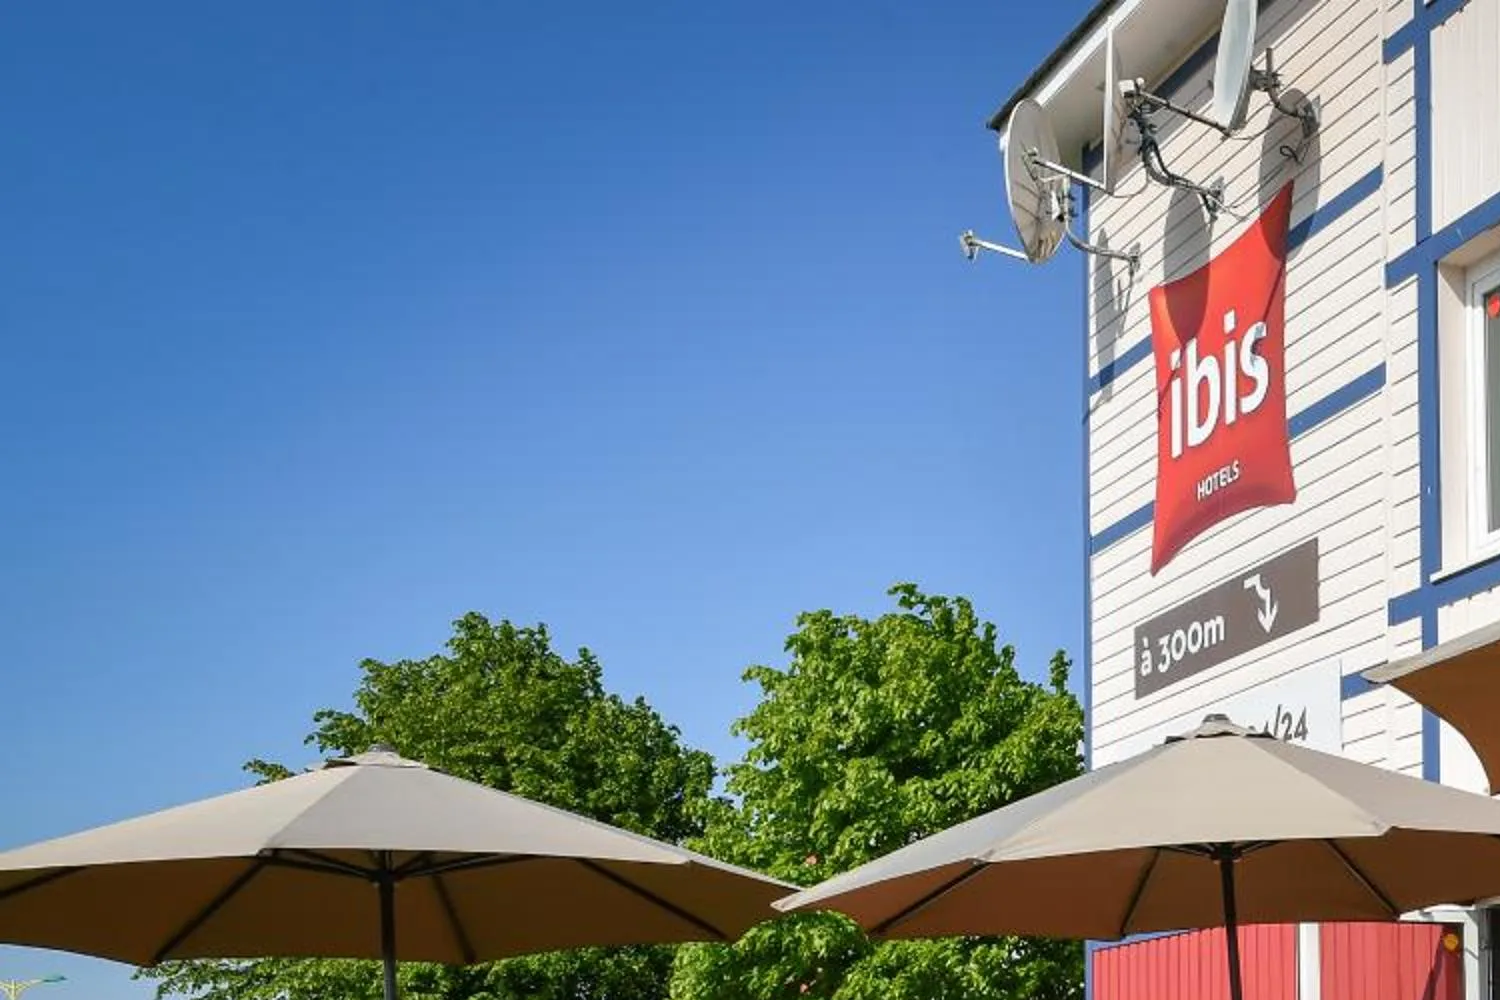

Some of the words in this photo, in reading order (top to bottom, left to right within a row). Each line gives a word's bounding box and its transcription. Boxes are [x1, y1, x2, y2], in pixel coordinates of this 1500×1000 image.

[1171, 309, 1269, 459] ibis
[1197, 459, 1240, 502] HOTELS
[1141, 636, 1152, 677] à
[1158, 615, 1225, 673] 300m
